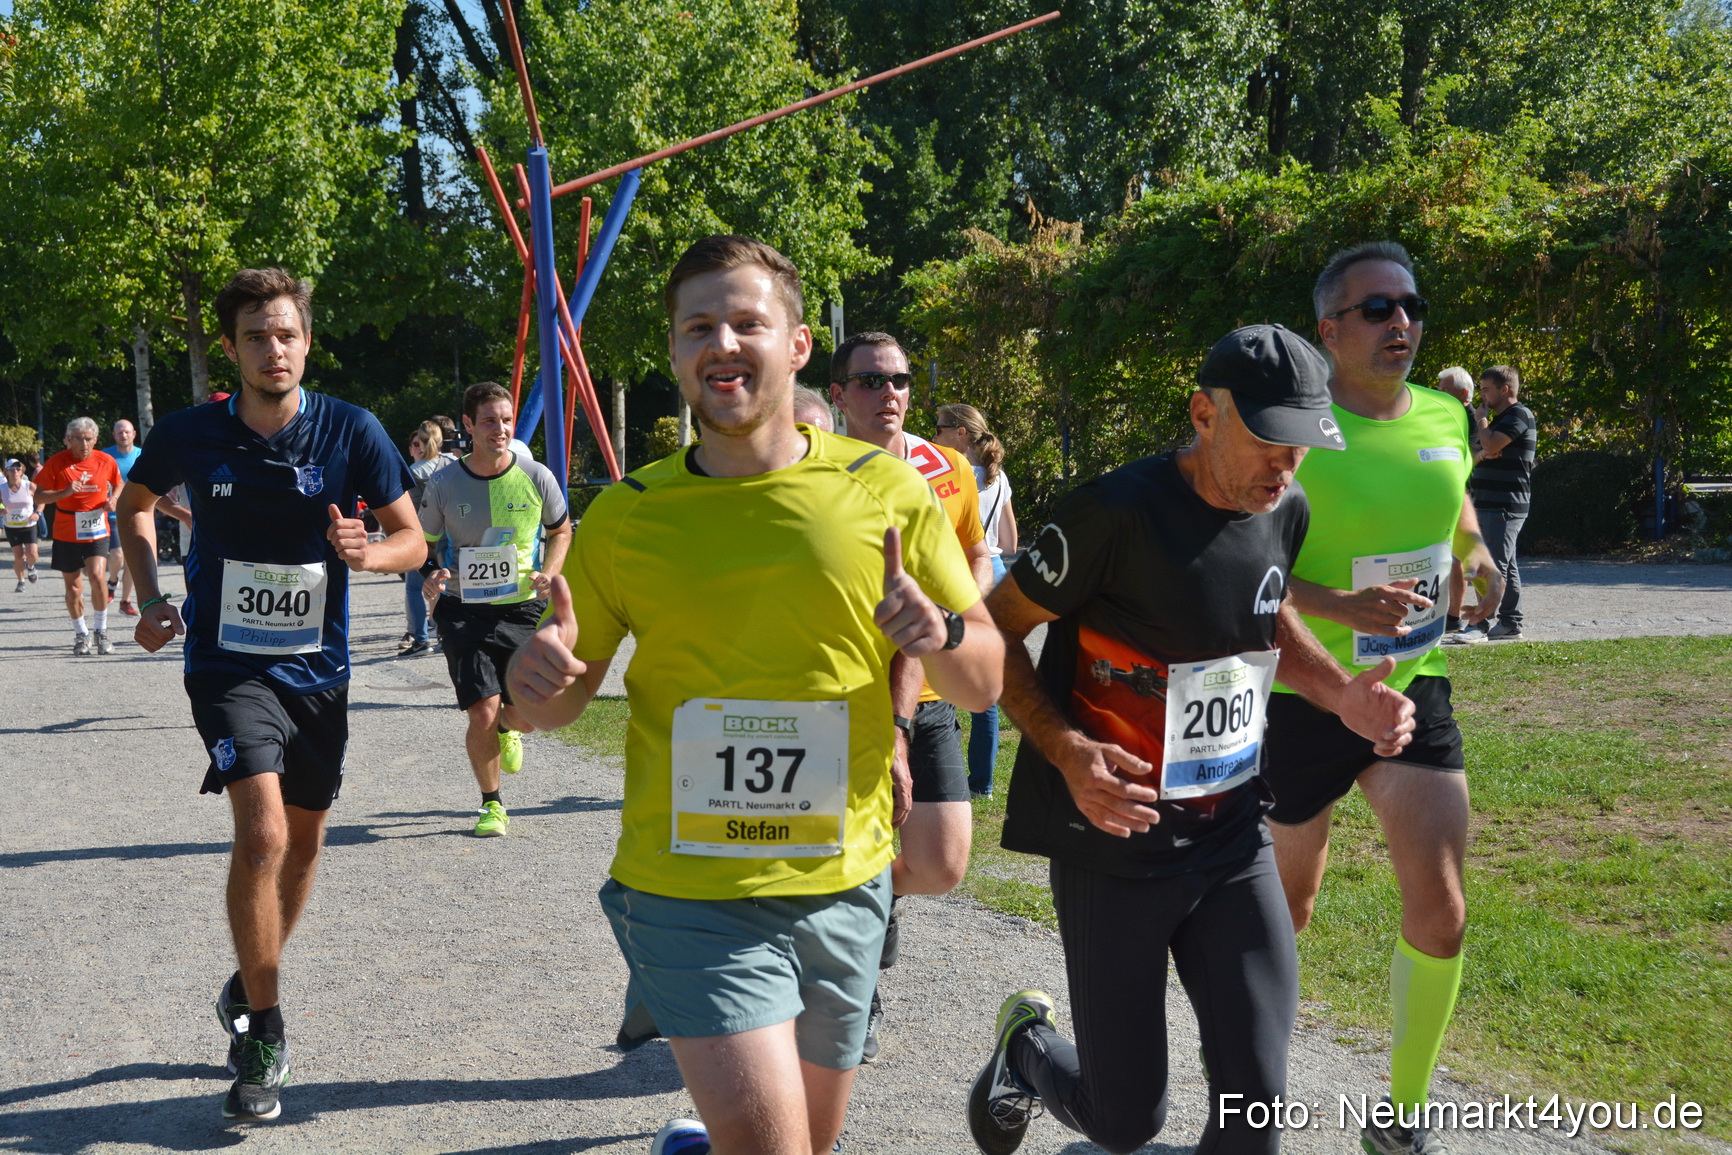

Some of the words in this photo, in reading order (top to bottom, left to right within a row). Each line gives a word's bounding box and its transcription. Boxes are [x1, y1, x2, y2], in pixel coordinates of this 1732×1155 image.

[212, 483, 233, 497] PM
[468, 561, 510, 580] 2219
[1388, 557, 1432, 577] BOCK
[254, 570, 300, 583] BOCK
[237, 586, 311, 617] 3040
[484, 588, 498, 597] Ralf
[242, 617, 264, 626] PARTL
[1404, 614, 1431, 627] Neumarkt
[240, 628, 286, 646] Philipp
[1203, 665, 1248, 687] BOCK
[1183, 688, 1254, 740] 2060
[724, 715, 799, 733] BOCK
[1190, 744, 1217, 755] PARTL
[1218, 737, 1243, 751] Neumarkt
[716, 746, 806, 794] 137
[1195, 756, 1244, 781] Andreas
[682, 778, 689, 788] C
[708, 799, 744, 809] PARTL
[746, 802, 796, 810] Neumarkt
[726, 819, 790, 840] Stefan
